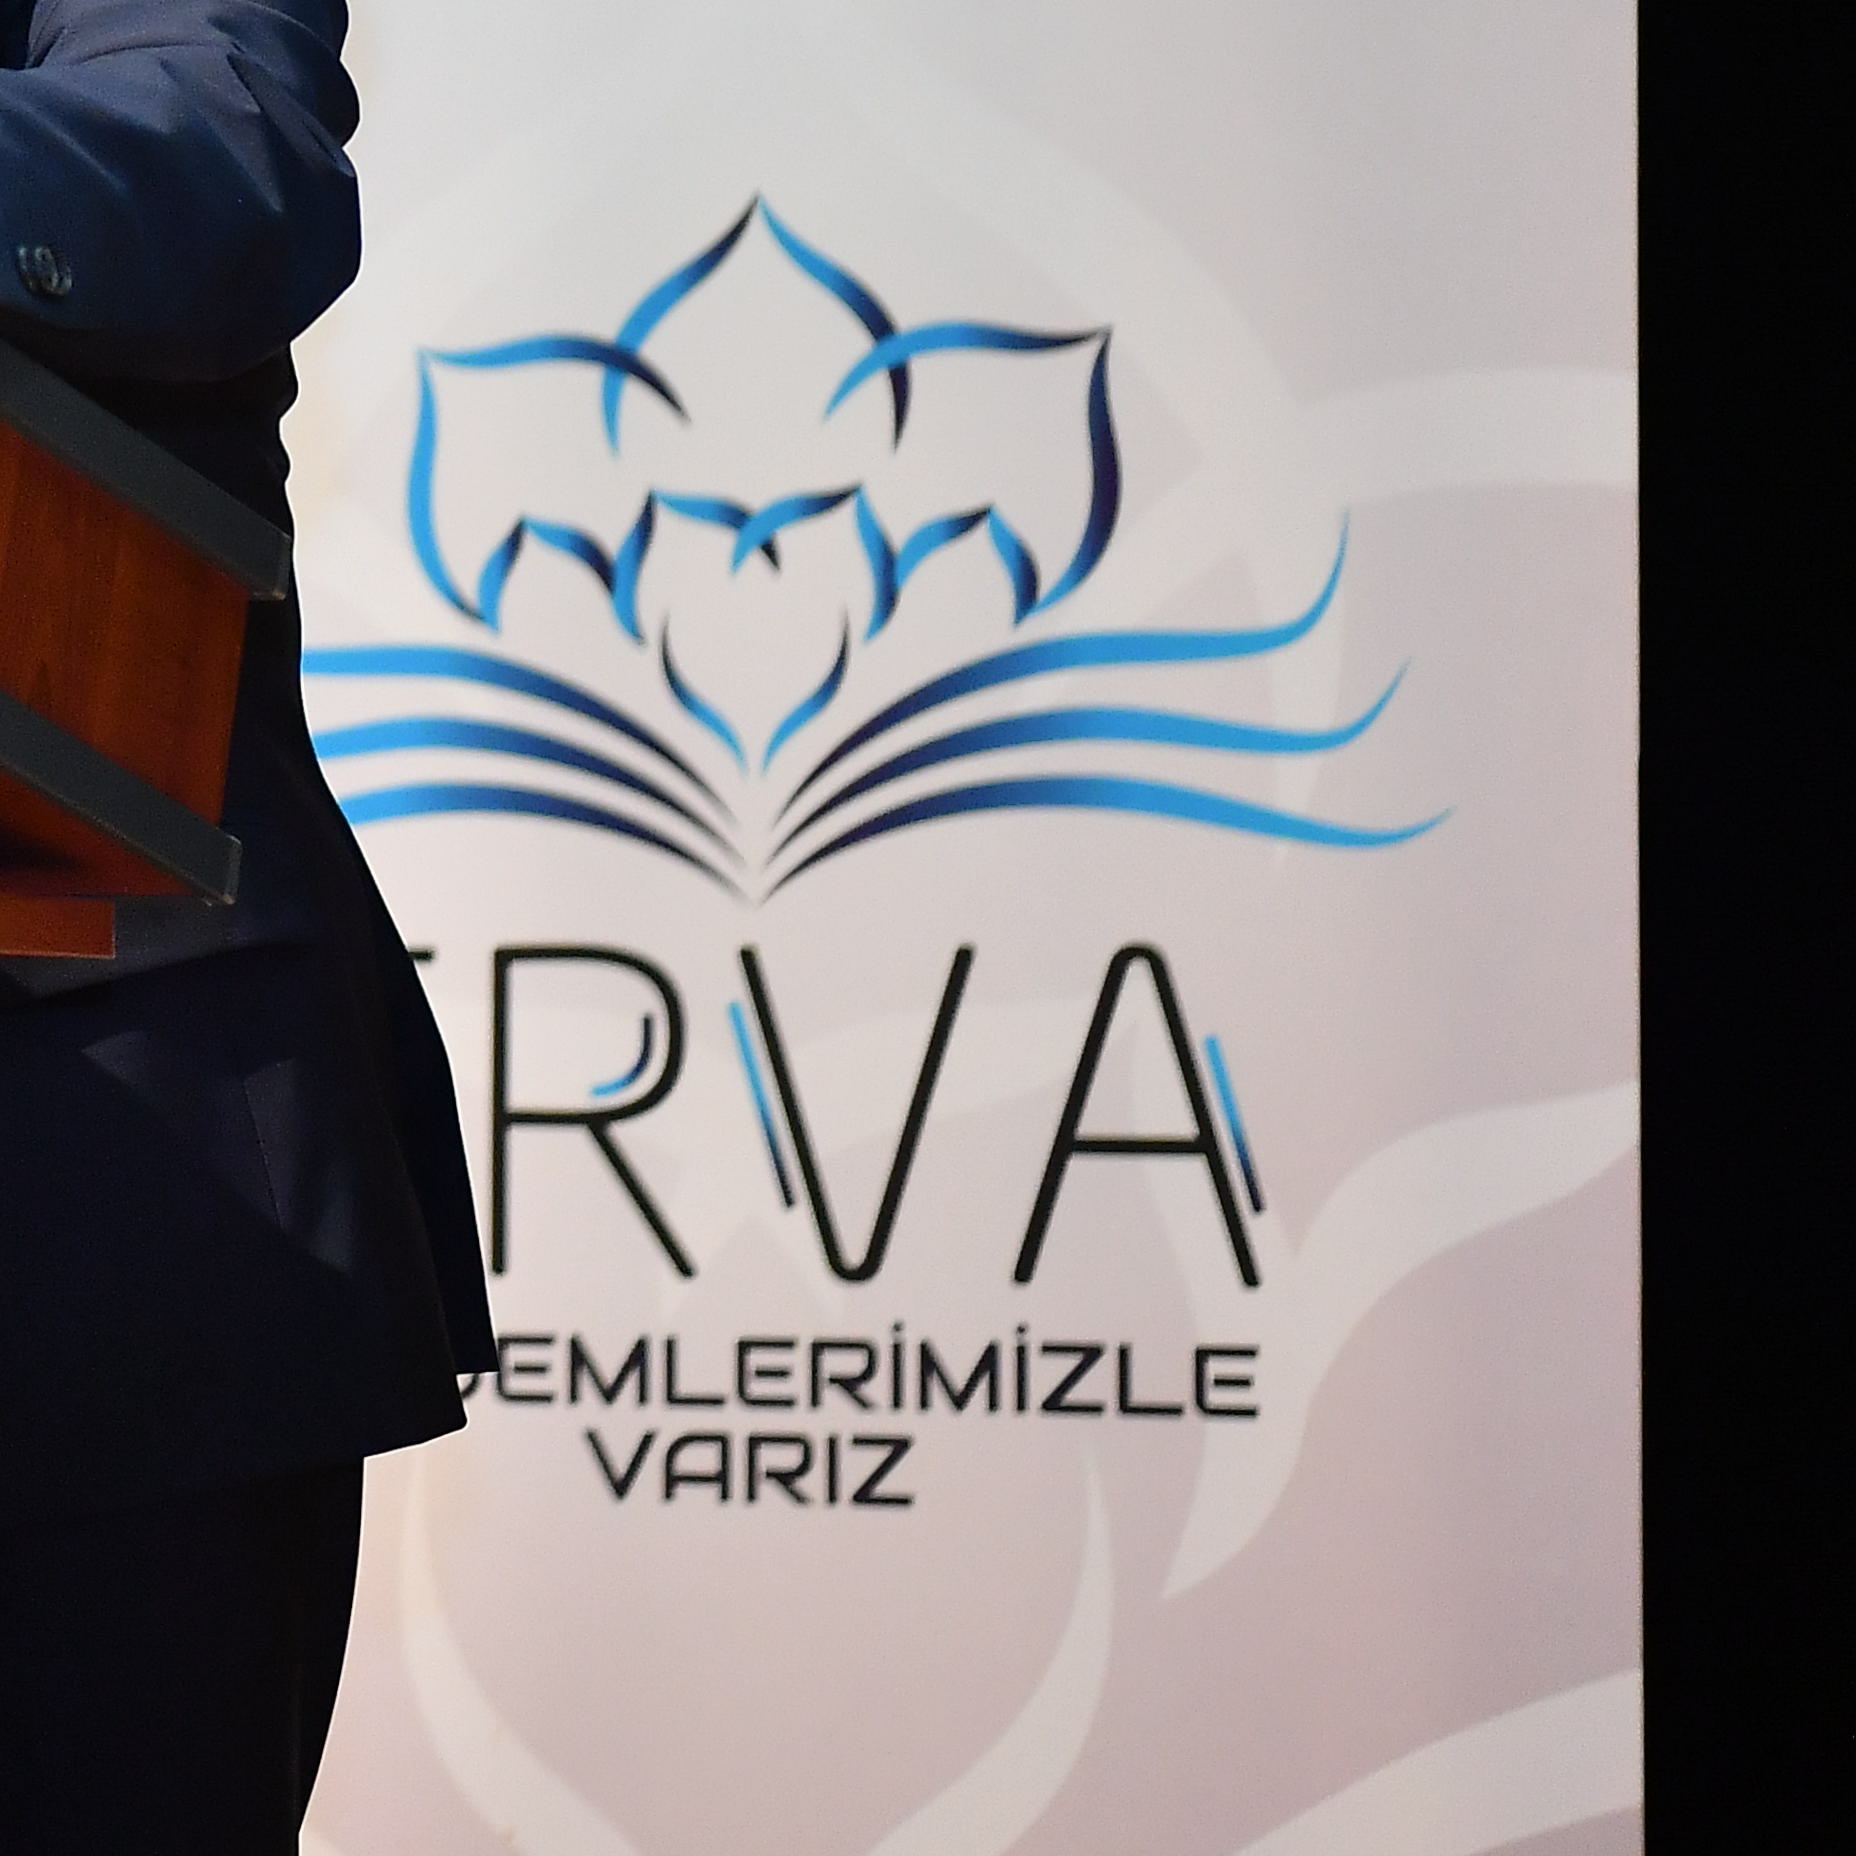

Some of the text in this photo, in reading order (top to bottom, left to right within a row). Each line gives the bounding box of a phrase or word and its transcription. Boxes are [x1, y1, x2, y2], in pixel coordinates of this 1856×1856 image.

[410, 942, 1265, 1289] RVA
[458, 1320, 1261, 1420] EMLERİMİZLE
[584, 1426, 916, 1508] VARIZ
